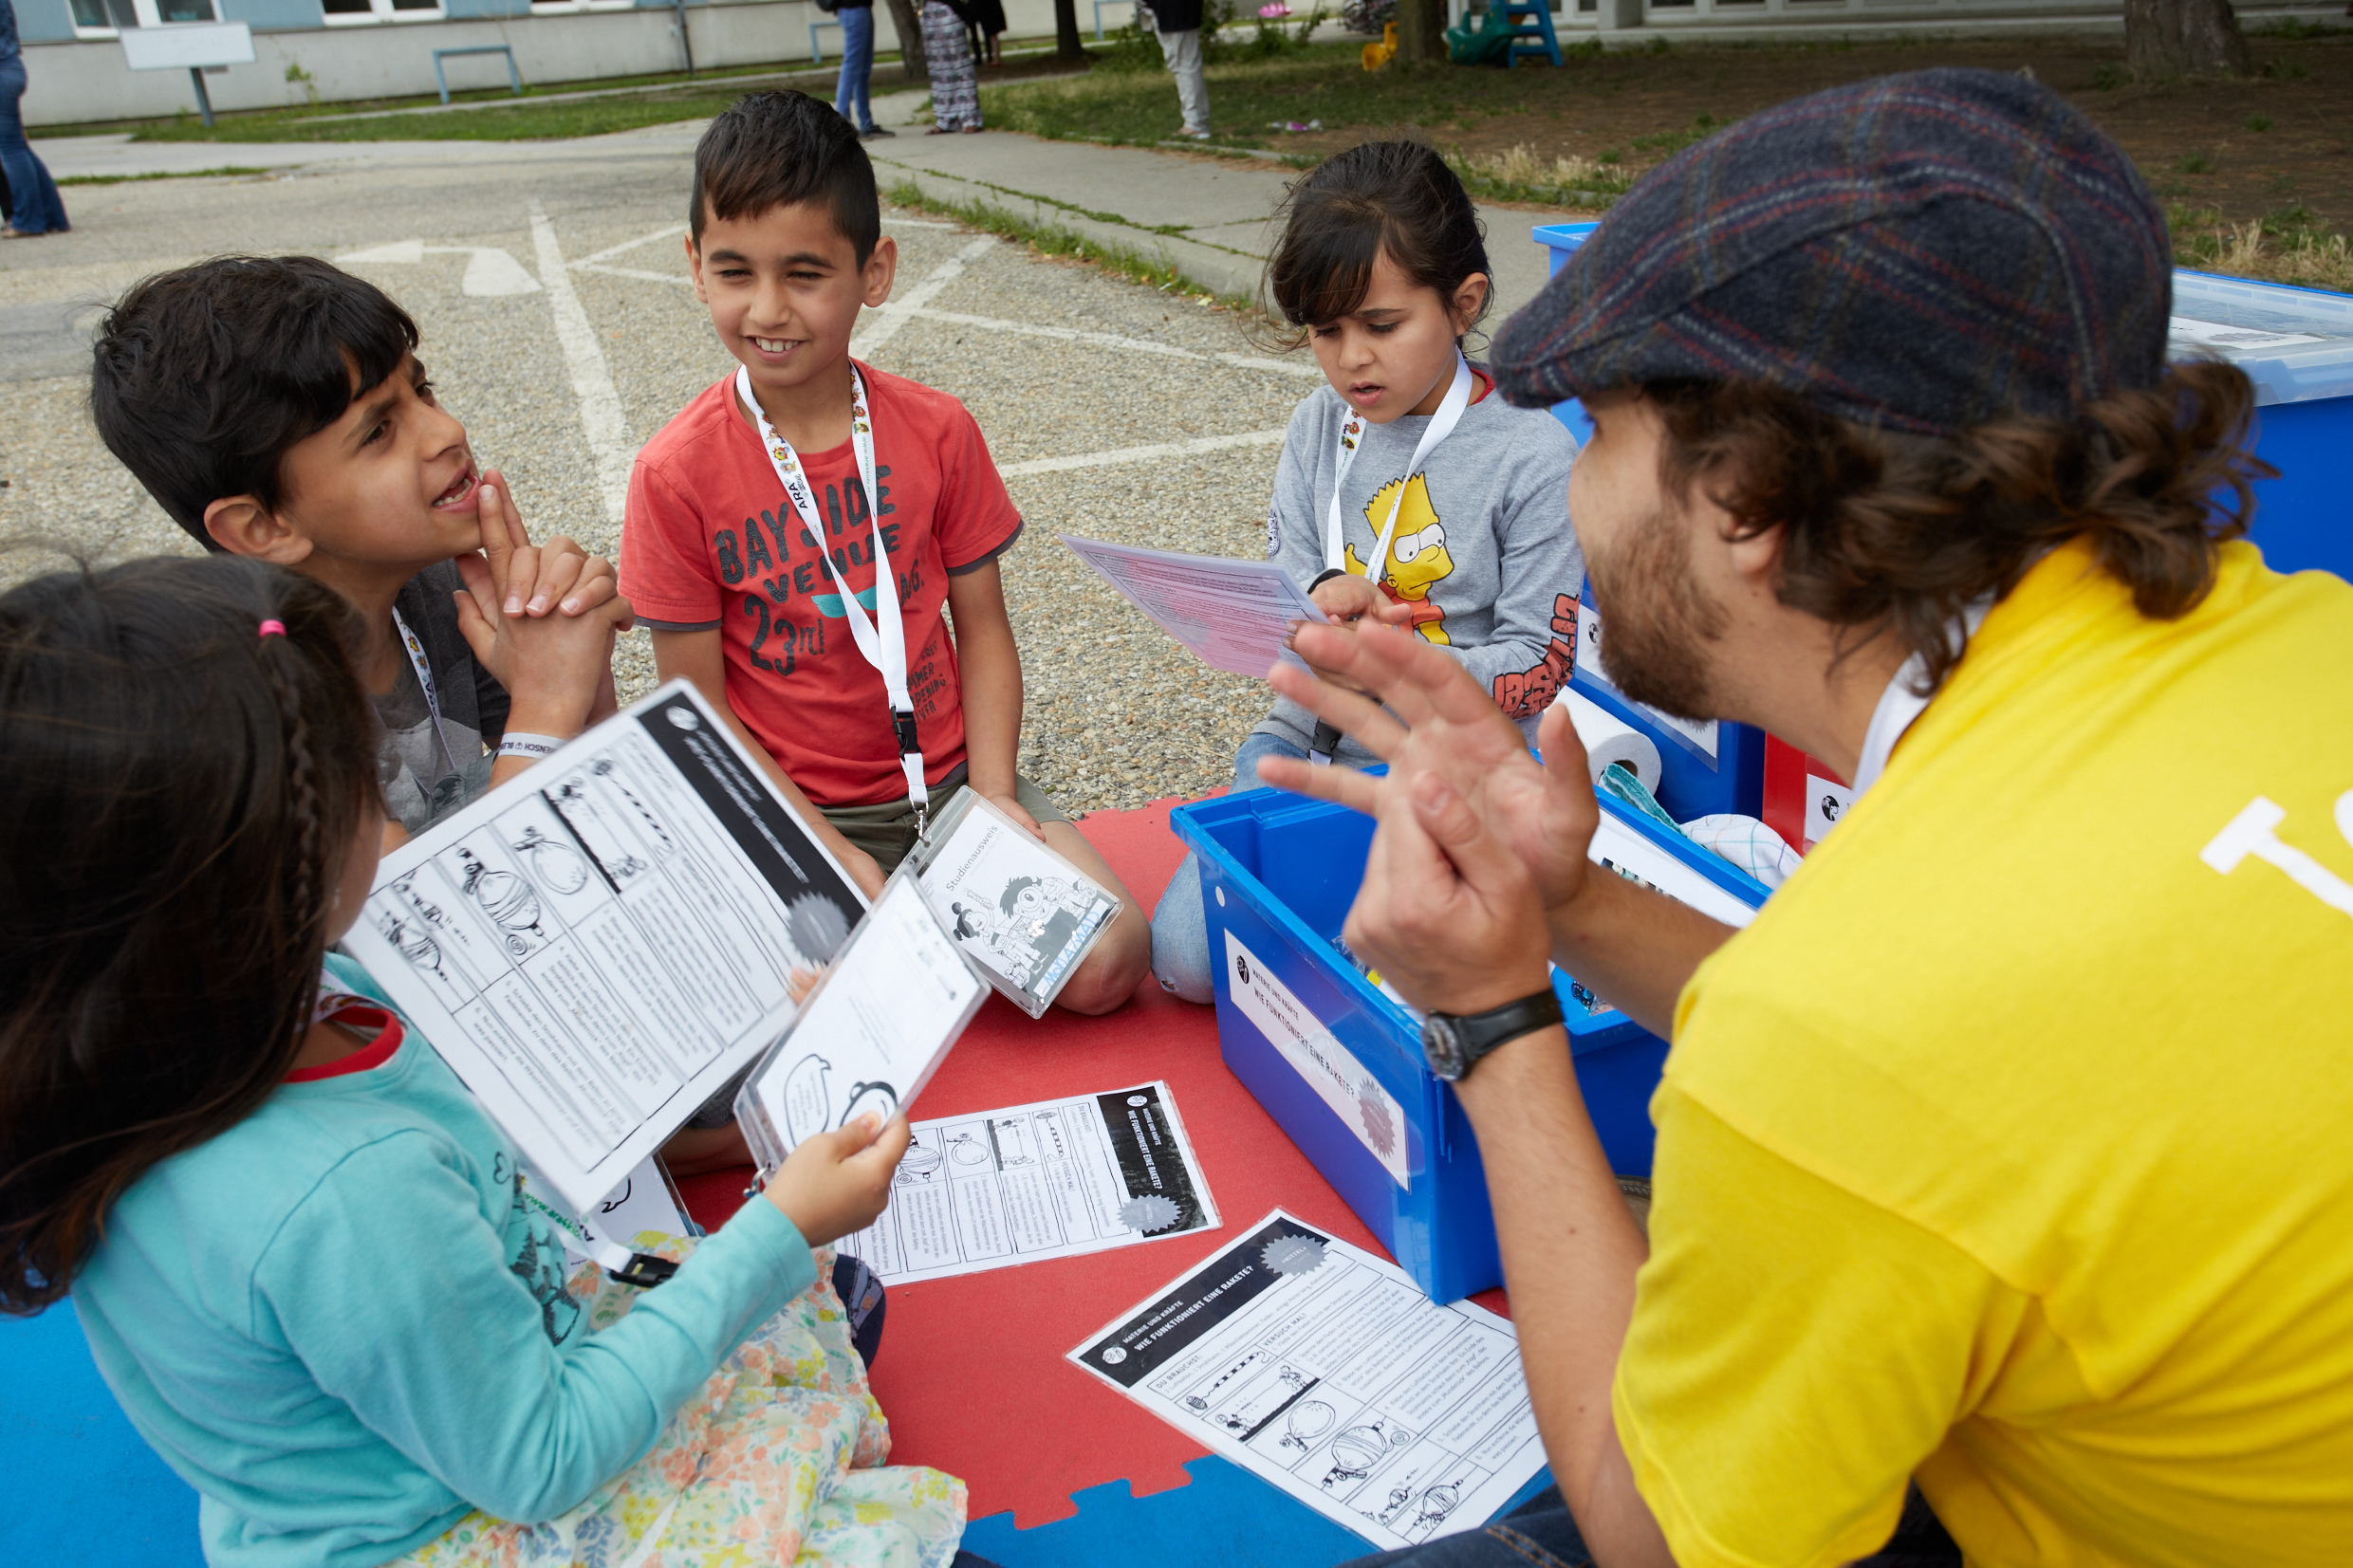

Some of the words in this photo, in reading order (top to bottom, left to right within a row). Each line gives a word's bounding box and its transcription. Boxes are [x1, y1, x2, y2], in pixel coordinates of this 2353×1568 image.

[788, 482, 808, 509] ARA
[946, 825, 998, 892] Studienausweis
[2198, 795, 2353, 922] T
[1253, 987, 1266, 1005] WIE
[1266, 999, 1308, 1050] FUNKTIONIERT
[1309, 1044, 1325, 1067] EINE
[1325, 1061, 1355, 1098] RAKETE?
[1126, 1110, 1137, 1118] WIE
[1130, 1119, 1149, 1153] FUNKTIONIERT
[1142, 1154, 1153, 1166] EINE
[1147, 1166, 1161, 1189] RAKETE?
[1121, 1324, 1150, 1343] MATERIE
[1146, 1315, 1162, 1325] UND
[1158, 1300, 1184, 1317] KRÄFTE
[1133, 1337, 1153, 1351] WIE
[1149, 1300, 1206, 1339] FUNKTIONIERT
[1201, 1287, 1224, 1302] EINE
[1219, 1264, 1256, 1289] RAKETE?
[1262, 1324, 1291, 1346] VERSUCH
[1289, 1312, 1306, 1324] MAL!
